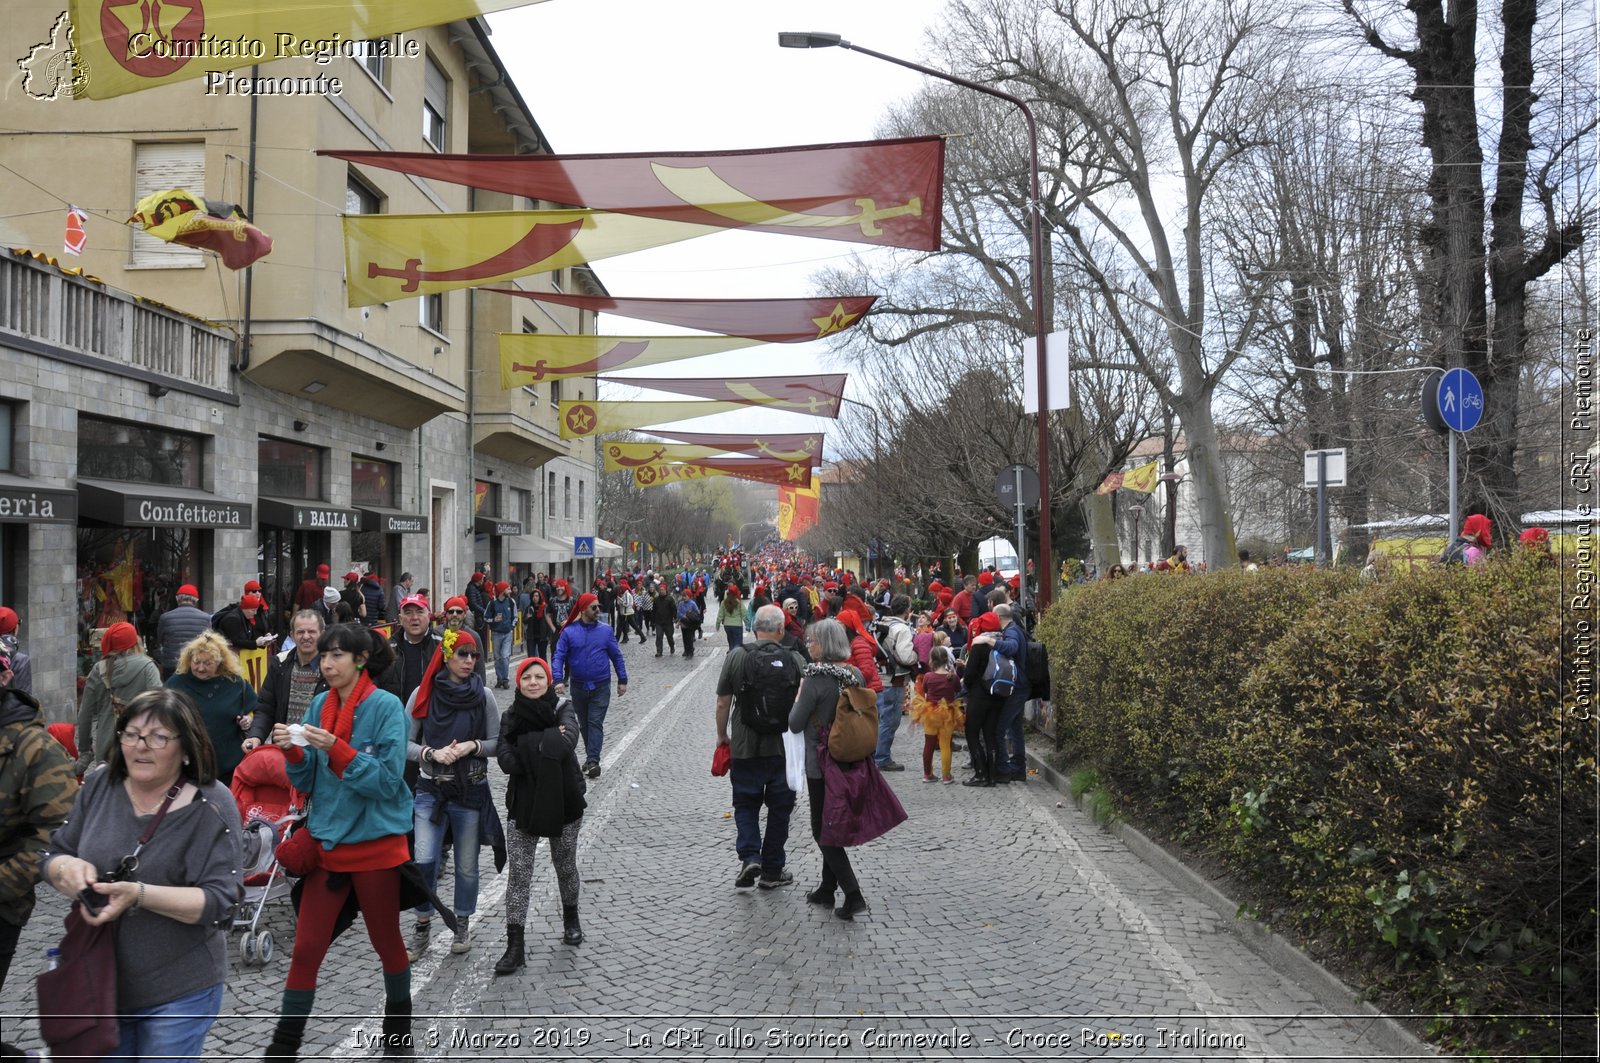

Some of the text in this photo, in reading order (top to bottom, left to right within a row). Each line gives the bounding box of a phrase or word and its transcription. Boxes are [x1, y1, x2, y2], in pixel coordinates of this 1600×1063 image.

[0, 493, 55, 518] eria
[139, 500, 241, 525] Confetteria
[309, 510, 349, 528] BALLA
[388, 517, 421, 531] Cremeria
